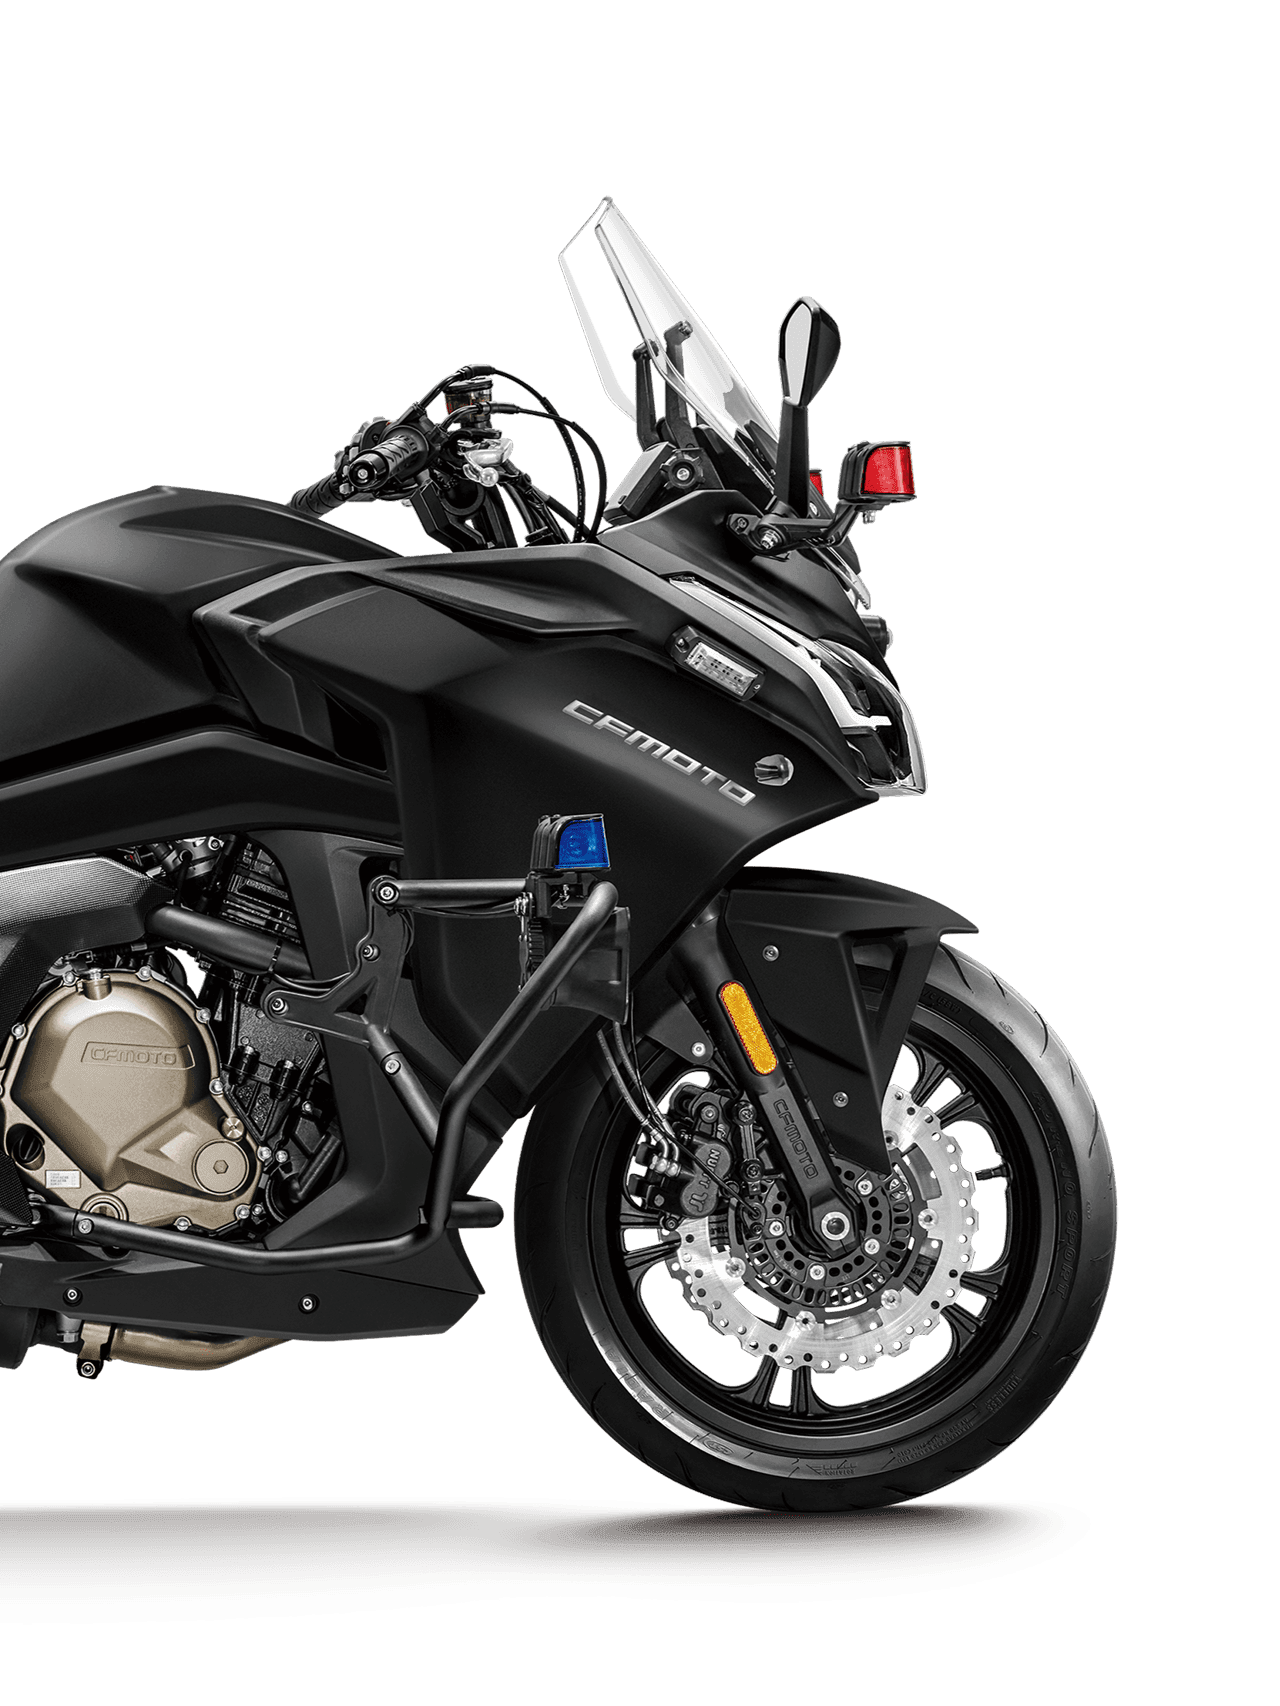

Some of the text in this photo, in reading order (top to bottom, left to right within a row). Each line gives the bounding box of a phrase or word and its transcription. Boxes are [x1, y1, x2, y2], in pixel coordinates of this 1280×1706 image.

[564, 700, 755, 806] CFMOTO
[91, 1046, 178, 1066] CFMOTO
[773, 1098, 818, 1180] CFMOTO
[1056, 1209, 1079, 1299] SPORT
